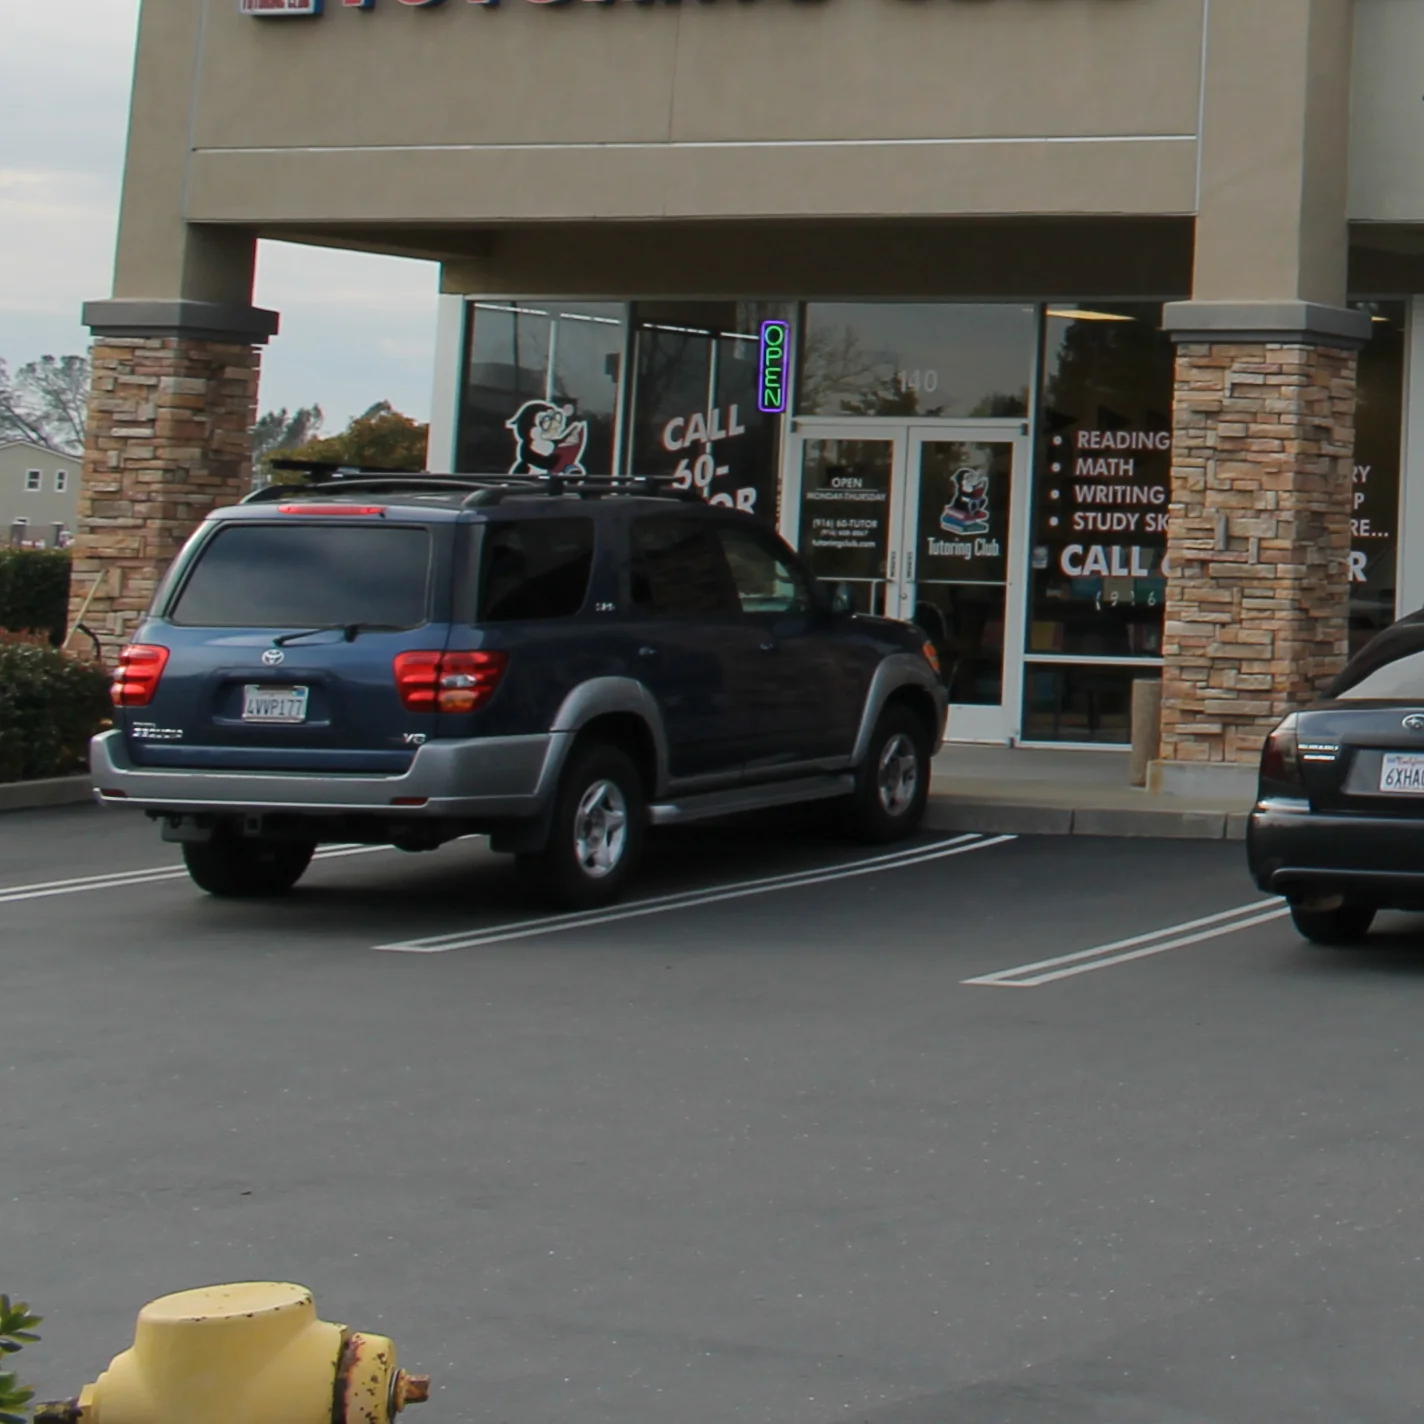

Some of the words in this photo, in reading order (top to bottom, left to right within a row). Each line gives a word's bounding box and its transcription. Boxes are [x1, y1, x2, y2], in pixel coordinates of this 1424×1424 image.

[763, 325, 784, 407] OPEN
[663, 404, 746, 452] CALL
[1077, 430, 1171, 451] READING
[1075, 457, 1135, 477] MATH
[831, 477, 863, 489] OPEN
[1073, 485, 1166, 505] WRITING
[1073, 511, 1141, 531] STUDY
[927, 537, 972, 560] Tutoring
[974, 538, 1000, 557] Club
[1060, 544, 1148, 577] CALL
